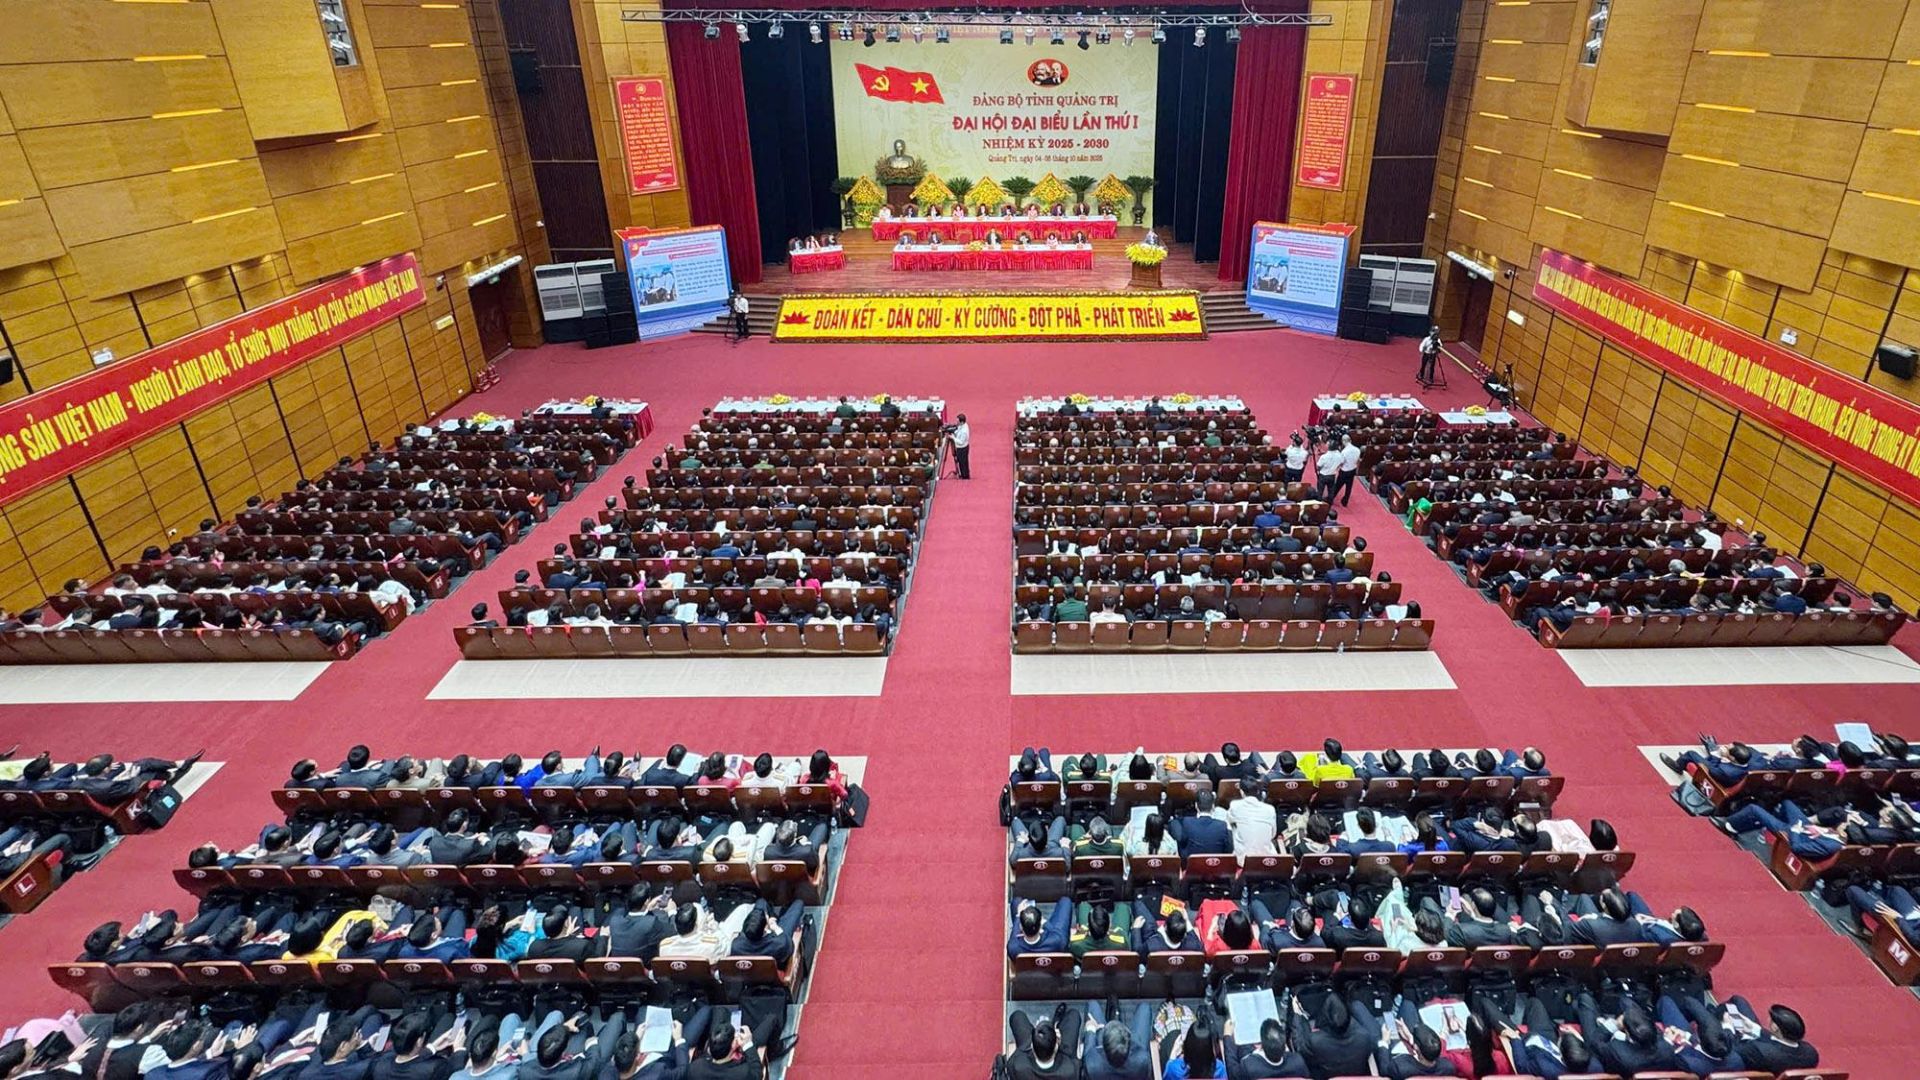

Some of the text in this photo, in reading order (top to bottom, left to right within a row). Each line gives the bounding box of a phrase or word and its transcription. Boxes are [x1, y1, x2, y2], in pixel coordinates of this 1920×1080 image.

[973, 91, 1118, 108] ĐẢNG BỘ TỈNH QUẢNG TRỊ
[952, 110, 1139, 133] ĐẠI HỘI ĐẠI BIỂU LẦN THỨ I
[983, 136, 1024, 151] NHIỆM
[1028, 135, 1045, 149] KỲ
[1048, 139, 1074, 149] 2025
[1083, 139, 1109, 149] 2030
[813, 304, 849, 330] ĐOÀN
[851, 300, 876, 329] KẾT
[887, 303, 913, 329] DÂN
[916, 299, 943, 329] CHỦ
[975, 303, 1017, 329] CƯƠNG
[1028, 303, 1052, 332] ĐỘT
[1056, 302, 1082, 328] PHÁ
[1093, 302, 1124, 328] PHÁT
[1128, 298, 1166, 328] TRIỂN
[19, 412, 62, 461] SẢN
[53, 402, 94, 447] VIỆT
[87, 391, 129, 432] NAM
[129, 366, 176, 414] NGƯỜI
[168, 359, 206, 396] LÃNH
[225, 330, 244, 371] TỔ
[240, 327, 271, 365] CHỨC
[266, 319, 290, 355] MỌI
[285, 306, 317, 345] THẮNG
[313, 301, 331, 335] LỢI
[328, 292, 348, 327] CỦA
[343, 288, 369, 319] CÁCH
[363, 280, 389, 313] MẠNG
[384, 272, 403, 302] VIỆT
[398, 267, 419, 294] NAM
[1834, 396, 1856, 440] BỀN
[1849, 409, 1877, 451] VỮNG
[1869, 420, 1904, 464] TRONG
[127, 800, 142, 818] K
[1787, 853, 1800, 873] L
[1889, 942, 1908, 963] M
